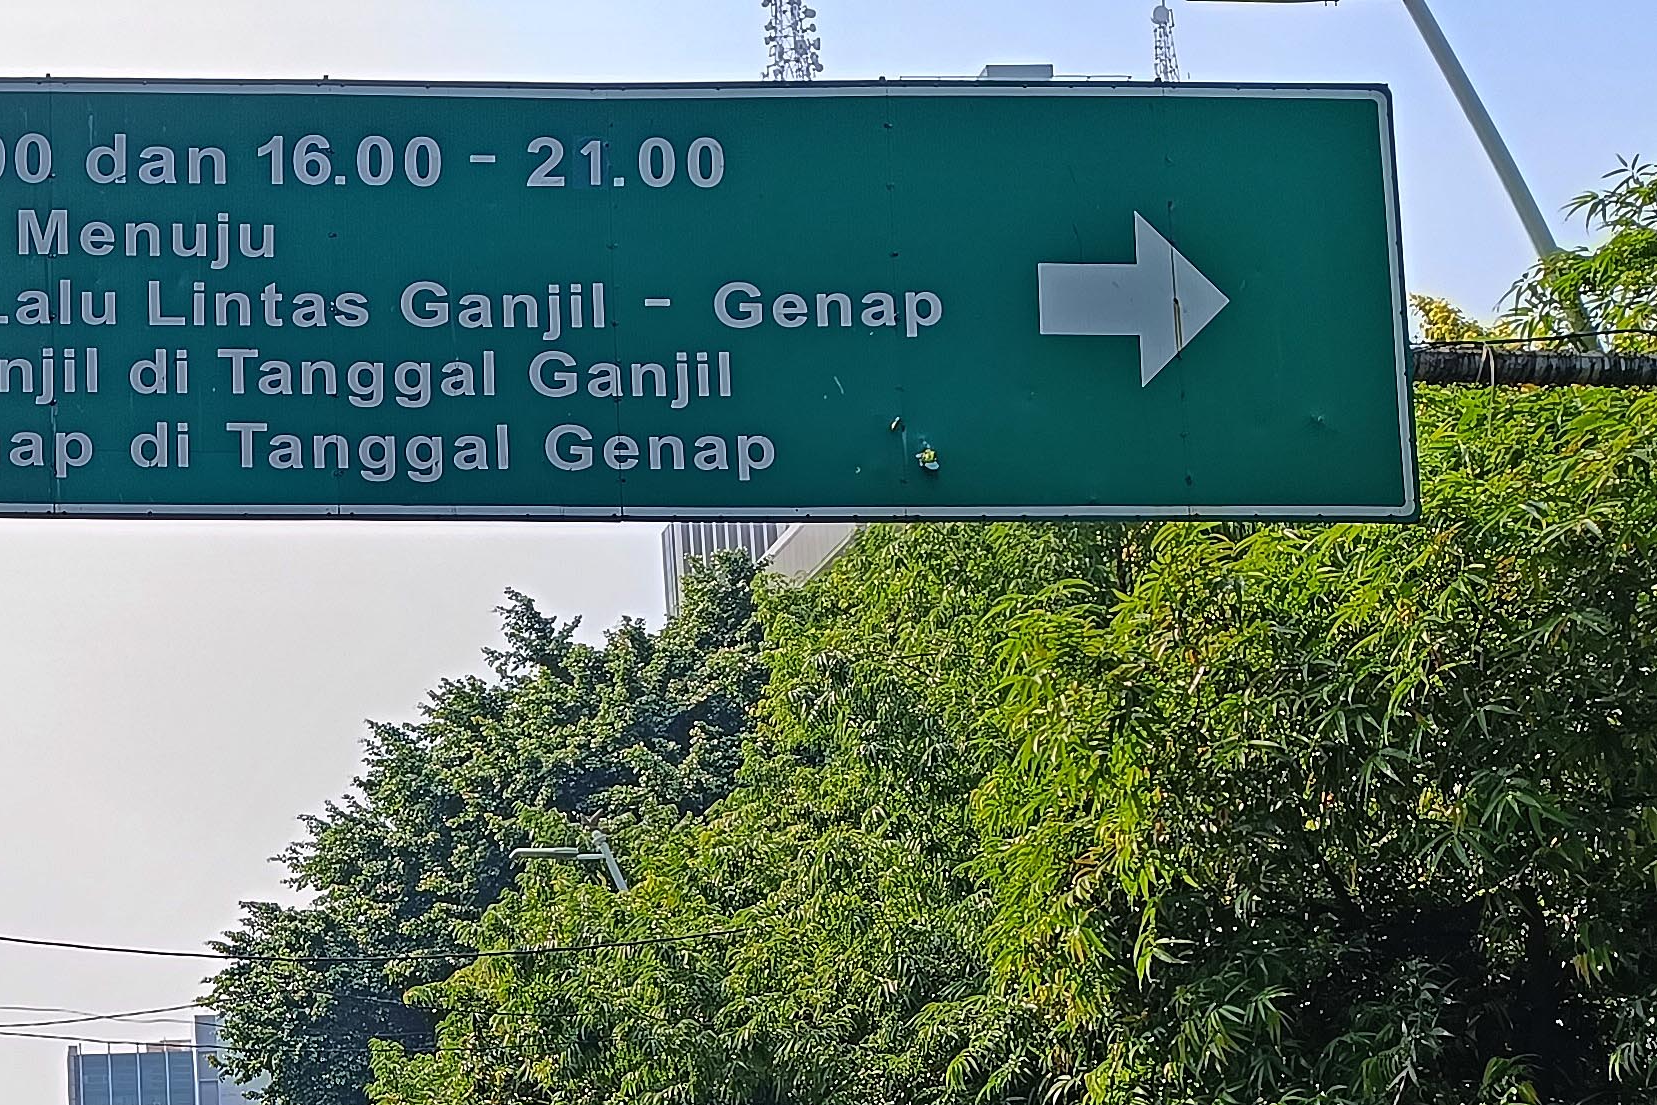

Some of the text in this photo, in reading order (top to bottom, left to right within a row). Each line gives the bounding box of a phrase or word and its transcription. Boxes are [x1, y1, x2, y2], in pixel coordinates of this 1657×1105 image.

[86, 133, 227, 185] dan
[258, 135, 441, 187] 16.00
[527, 137, 724, 188] 21.00
[19, 210, 275, 270] Menuju
[149, 281, 369, 328] Lintas
[401, 282, 605, 341] Ganjil
[714, 282, 942, 338] Genap
[130, 349, 188, 395] di
[218, 349, 495, 408] Tanggal
[529, 351, 731, 409] Ganjil
[131, 422, 189, 468] di
[227, 423, 509, 482] Tanggal
[545, 425, 775, 481] Genap
